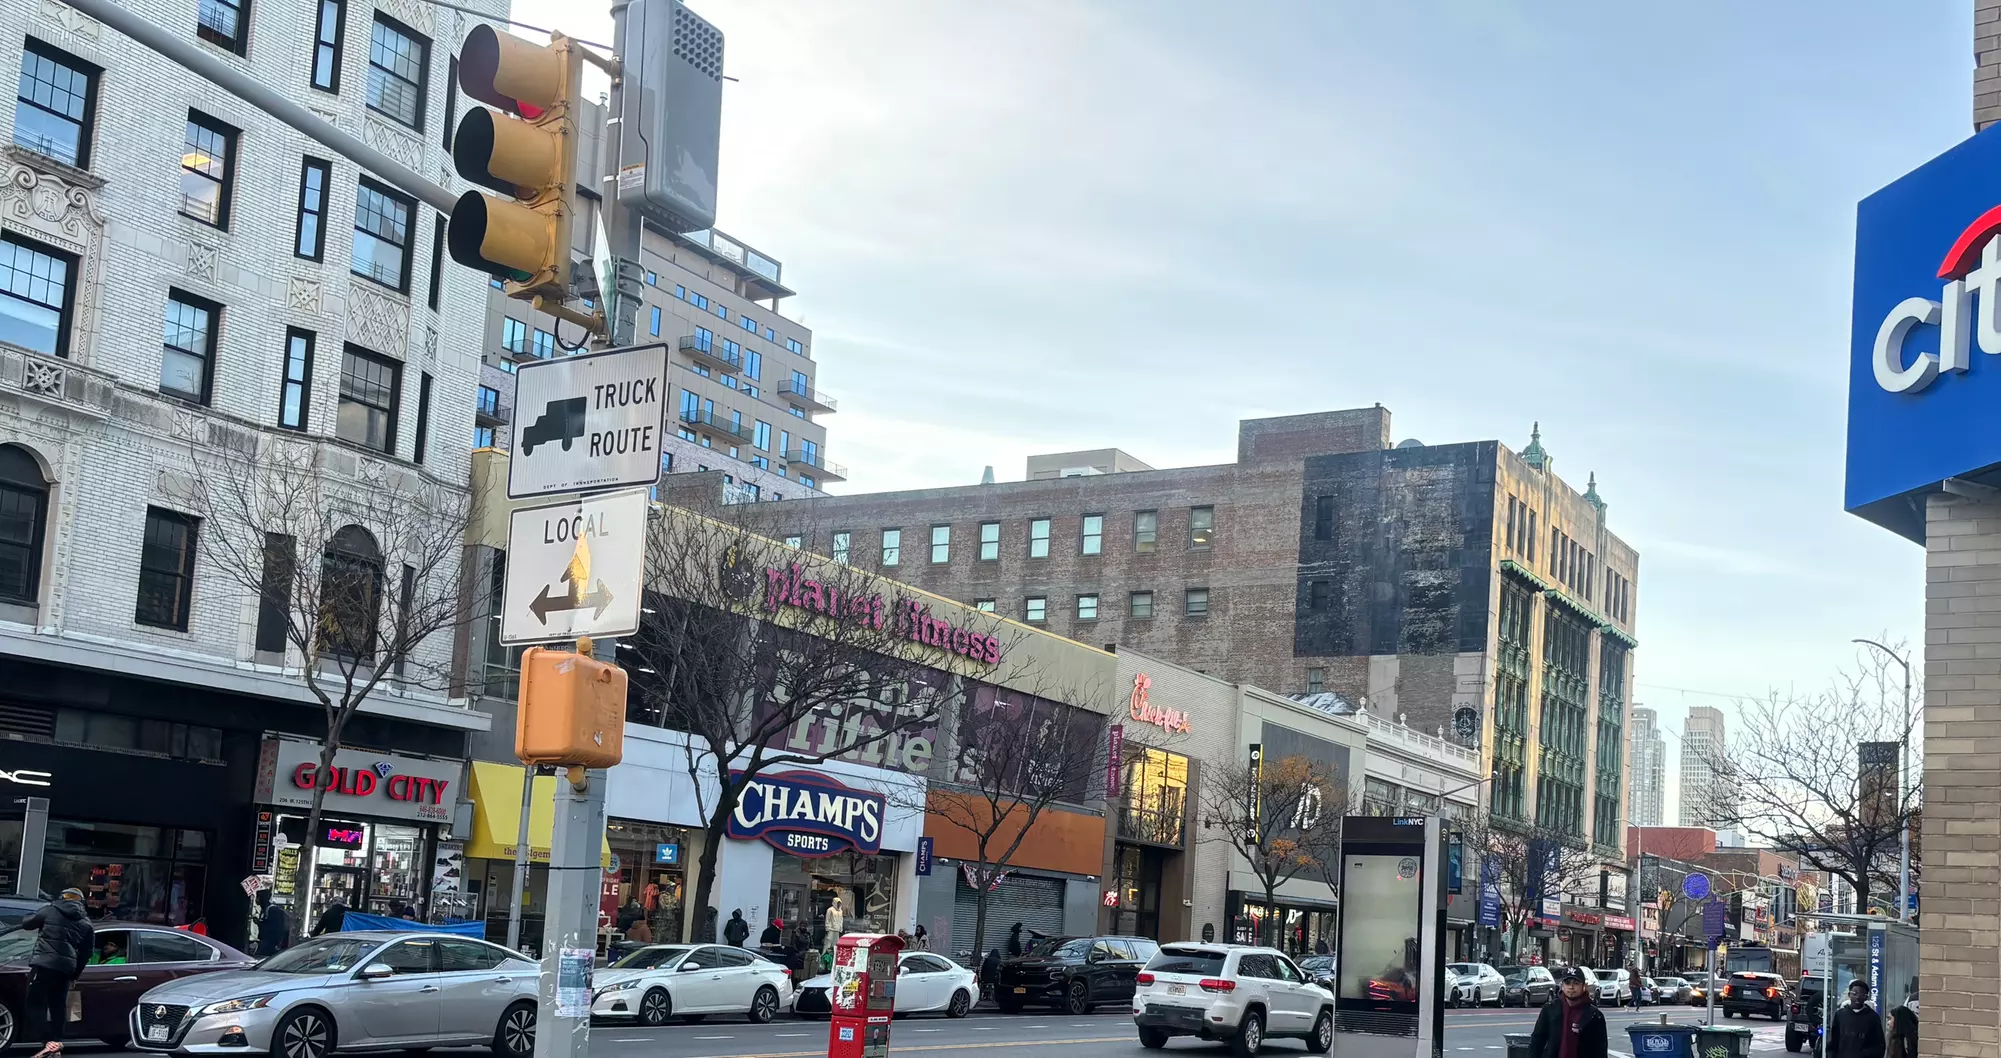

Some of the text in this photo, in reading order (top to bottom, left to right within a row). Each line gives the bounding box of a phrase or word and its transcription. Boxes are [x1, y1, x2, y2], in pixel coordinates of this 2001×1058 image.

[594, 377, 658, 411] TRUCK
[589, 425, 654, 458] ROUTE
[544, 511, 610, 545] LOCAL
[761, 562, 882, 631] planet
[294, 762, 449, 805] GOLD CITY
[734, 780, 879, 843] CHAMPS
[1393, 818, 1424, 826] LinkNYC
[503, 847, 517, 856] the
[787, 833, 829, 851] SPORTS
[919, 840, 928, 872] CHAMPS
[603, 884, 619, 896] LE
[1871, 948, 1879, 957] St
[1871, 965, 1879, 987] Adam
